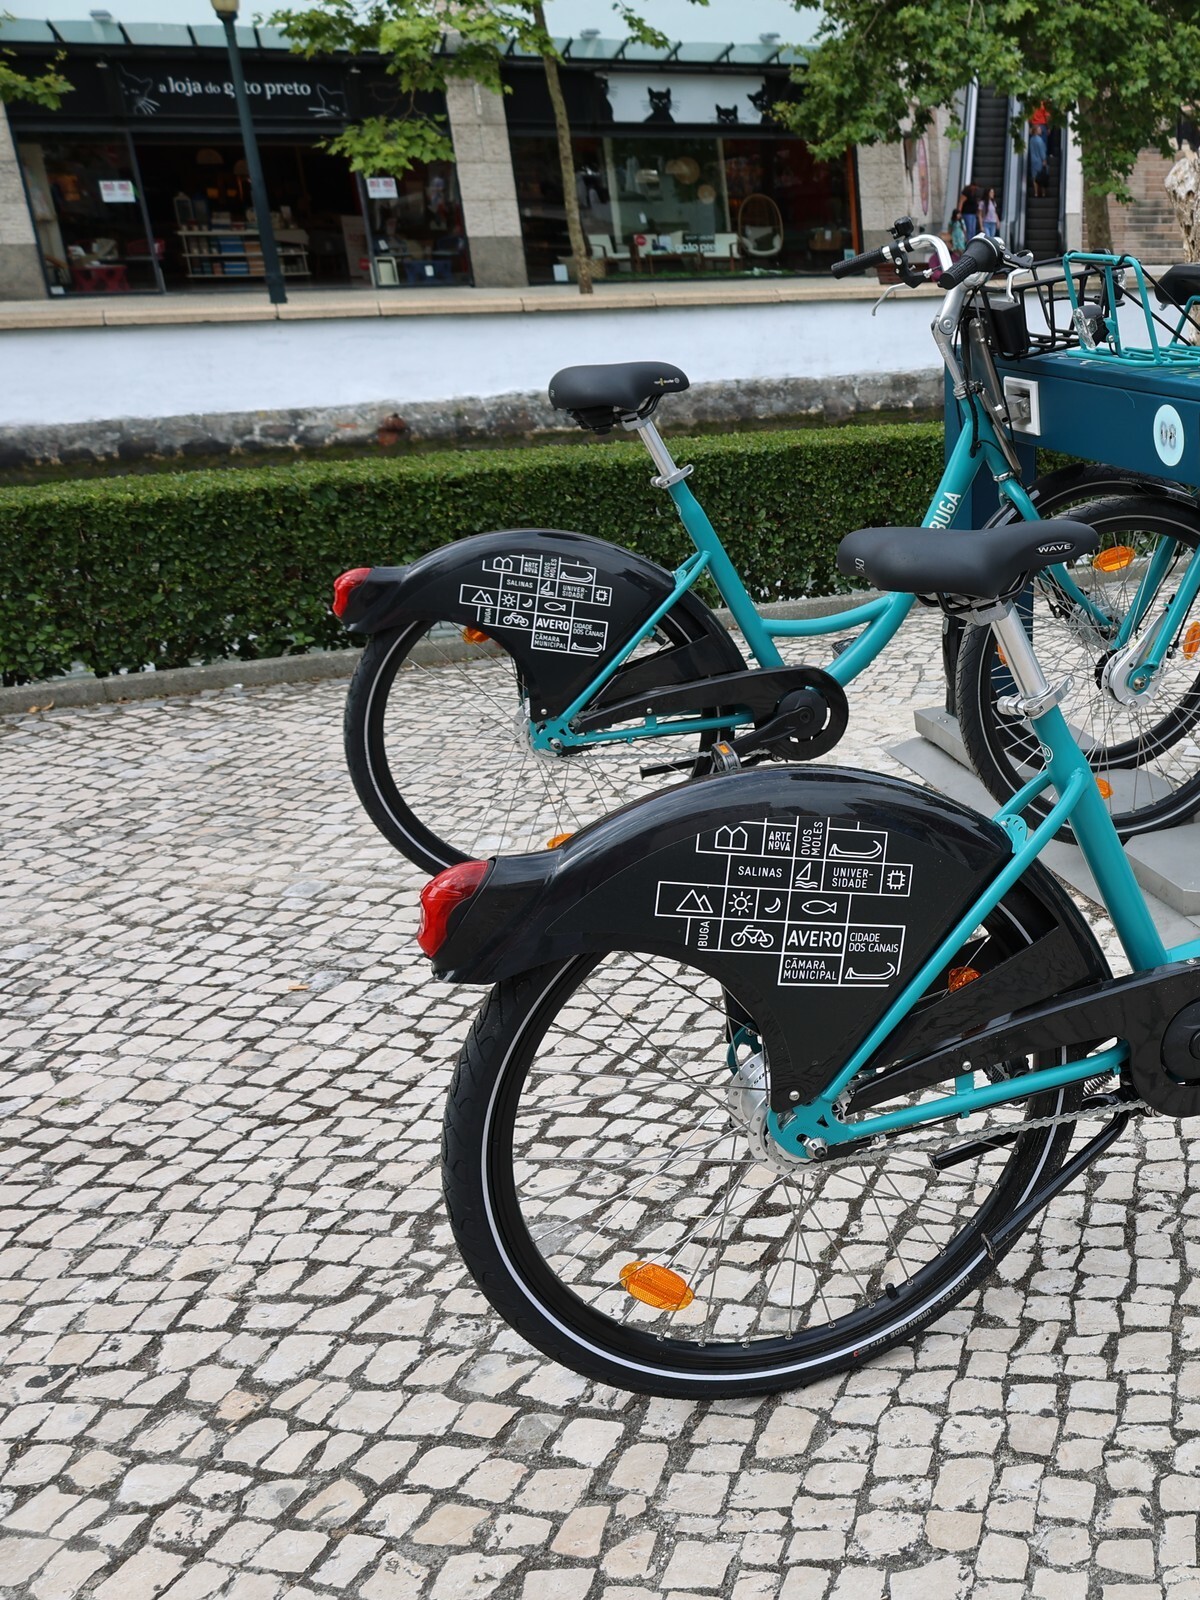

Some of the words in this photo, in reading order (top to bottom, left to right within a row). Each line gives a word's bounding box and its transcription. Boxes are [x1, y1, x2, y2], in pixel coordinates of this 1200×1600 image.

[159, 83, 167, 93] a
[168, 76, 203, 97] loja
[204, 83, 221, 94] do
[223, 81, 262, 99] gto
[265, 83, 311, 100] preto
[928, 491, 962, 530] BUGA
[1038, 543, 1072, 554] WAVE
[523, 561, 539, 569] ARTE
[543, 561, 551, 578] OVOS
[549, 558, 557, 579] MOLES
[506, 578, 534, 589] SALINAS
[562, 584, 588, 594] UNIVER-
[561, 590, 585, 600] SIDADE
[483, 608, 492, 624] BUGA
[536, 617, 570, 631] AVEIRO
[573, 622, 593, 631] CIDADE
[573, 627, 585, 635] DOS
[584, 629, 605, 638] CANAIS
[534, 639, 567, 650] MUNICIPAL
[768, 830, 792, 842] ARTE
[800, 829, 813, 855] OVOS
[811, 821, 824, 856] MOLES
[767, 841, 791, 852] NOVA
[738, 865, 783, 878] SALINAS
[833, 867, 874, 879] UNIVER-
[831, 878, 868, 889] SIDADE
[698, 920, 710, 947] BUGA
[786, 929, 843, 948] AVEIRO
[849, 932, 881, 943] CIDADE
[848, 942, 866, 952] DOS
[868, 943, 899, 953] CANAIS
[783, 969, 837, 981] MUNICIPAL
[940, 1275, 971, 1305] HARTEX
[907, 1308, 932, 1328] URBAN
[889, 1325, 908, 1338] RIDE
